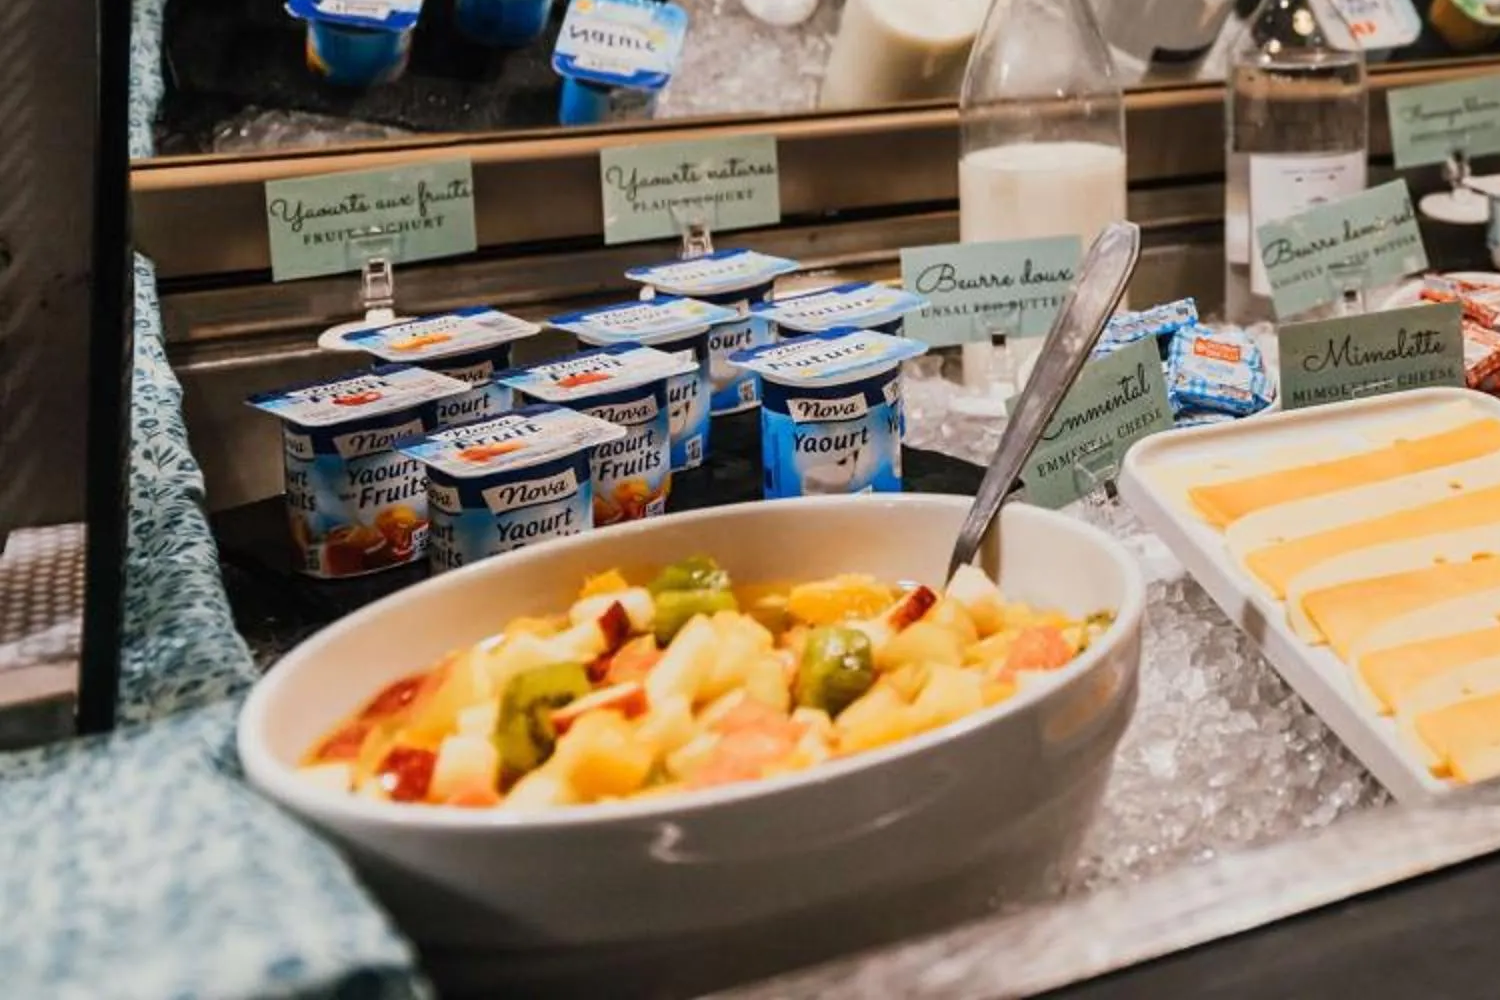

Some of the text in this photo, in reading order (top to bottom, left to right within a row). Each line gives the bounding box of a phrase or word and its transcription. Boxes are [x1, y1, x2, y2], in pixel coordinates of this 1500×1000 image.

[606, 158, 776, 201] Yaourts natures
[270, 179, 472, 232] Yaourts aux fruits
[915, 256, 1075, 295] Beurre doux
[709, 327, 753, 351] ourt
[1303, 327, 1447, 372] Mimolette
[440, 392, 490, 417] ourt
[669, 379, 698, 402] urt
[1042, 362, 1151, 441] mmental
[797, 400, 857, 418] Nova
[349, 428, 414, 451] Nov
[793, 426, 868, 454] Yaourt
[598, 450, 661, 481] Fruits
[359, 476, 431, 509] Fruits
[500, 478, 569, 505] Nova
[497, 507, 573, 542] Yaourt
